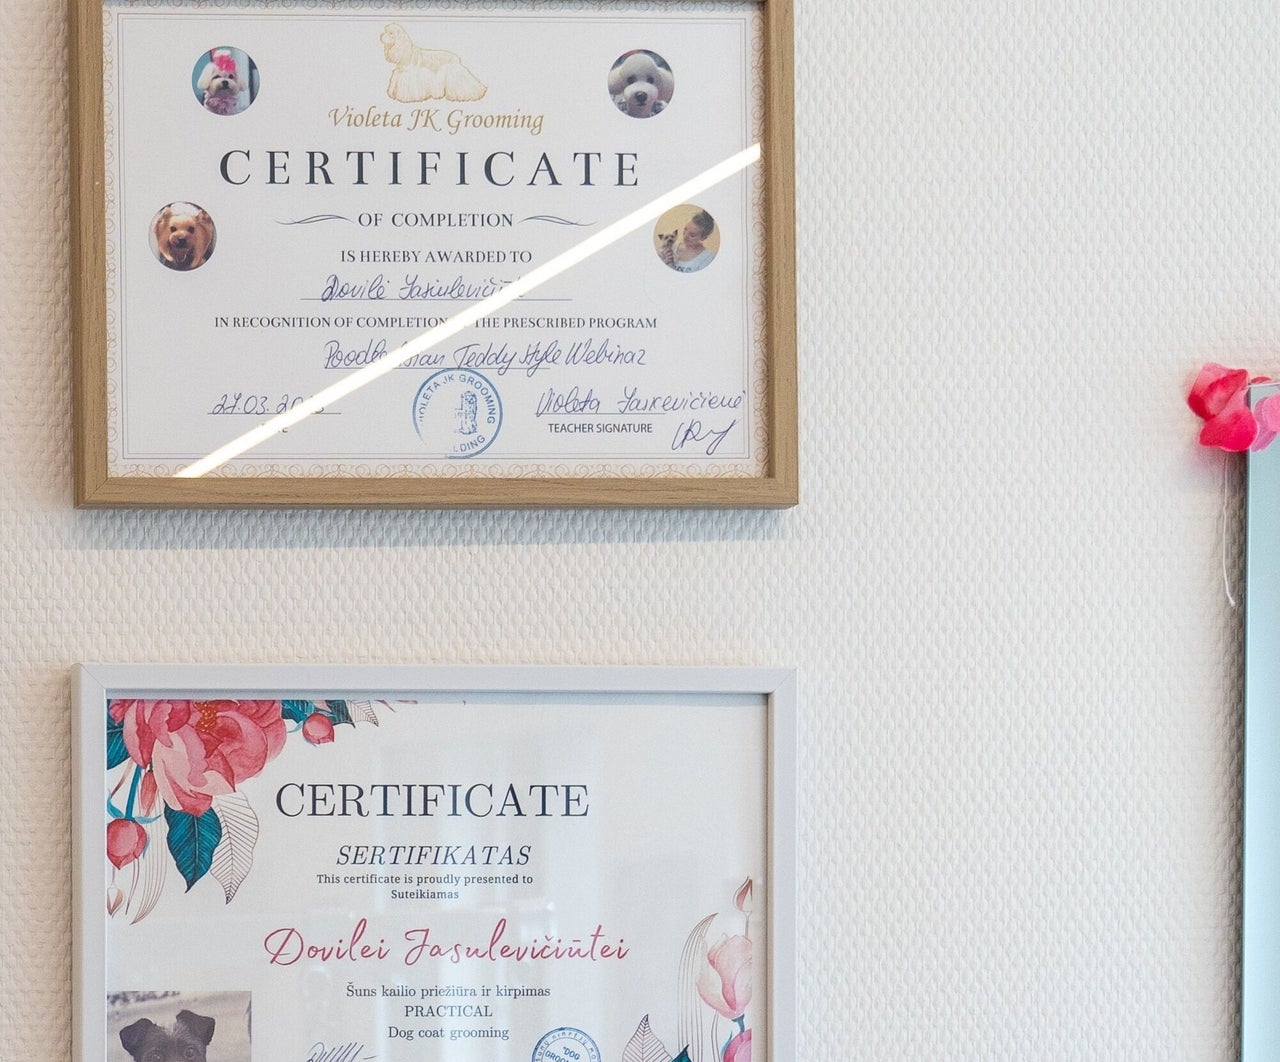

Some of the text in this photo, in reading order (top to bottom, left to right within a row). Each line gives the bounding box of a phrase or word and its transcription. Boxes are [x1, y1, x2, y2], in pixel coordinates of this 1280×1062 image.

[328, 107, 544, 135] Violeta JK Grooming
[219, 150, 638, 186] CERTIFICATE
[359, 213, 513, 227] OF COMPLETION
[341, 250, 532, 263] IS HEREBY AWARDED TO
[215, 317, 657, 328] IN RECOGNITION OF COMPLETION THE PRESCRIBED PROGRAM
[459, 375, 496, 424] GROOMING
[548, 423, 653, 433] TEACHER SIGNATURE
[276, 783, 589, 817] CERTIFICATE
[336, 845, 532, 865] SERTIFIKATAS
[317, 874, 533, 887] This certificate is proudly presented to
[391, 889, 459, 900] Suteikiamas
[264, 918, 390, 966] Dovilei
[346, 981, 551, 999] Šuns kailio priežiūra ir kirpimas
[405, 1005, 492, 1018] PRACTICAL
[388, 1027, 509, 1041] Dog coat grooming
